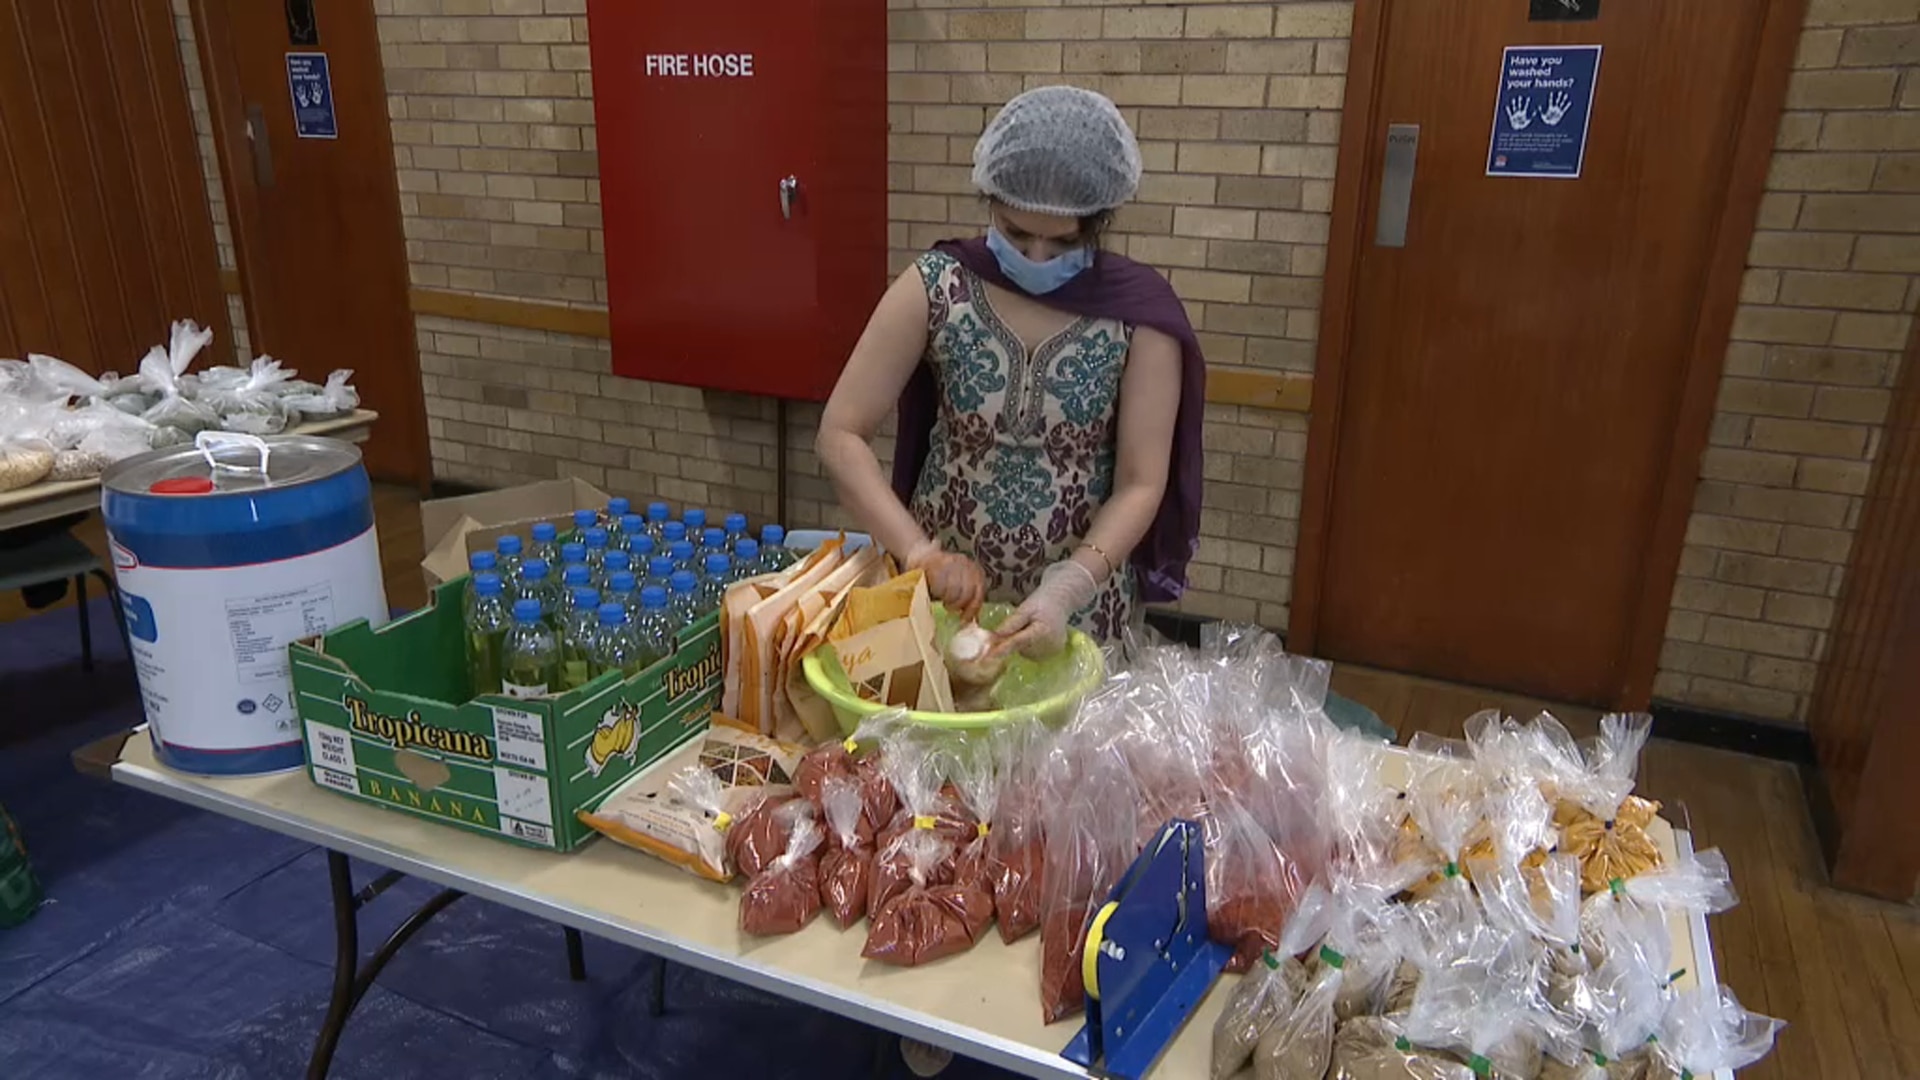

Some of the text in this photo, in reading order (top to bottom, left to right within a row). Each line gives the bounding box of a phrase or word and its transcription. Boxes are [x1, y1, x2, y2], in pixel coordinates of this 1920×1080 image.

[646, 53, 753, 77] FIRE HOSE
[1510, 55, 1563, 68] Have you
[1508, 67, 1552, 77] washed
[1507, 77, 1575, 91] your hands?
[346, 696, 491, 758] Tropicana
[371, 779, 485, 823] BANANA
